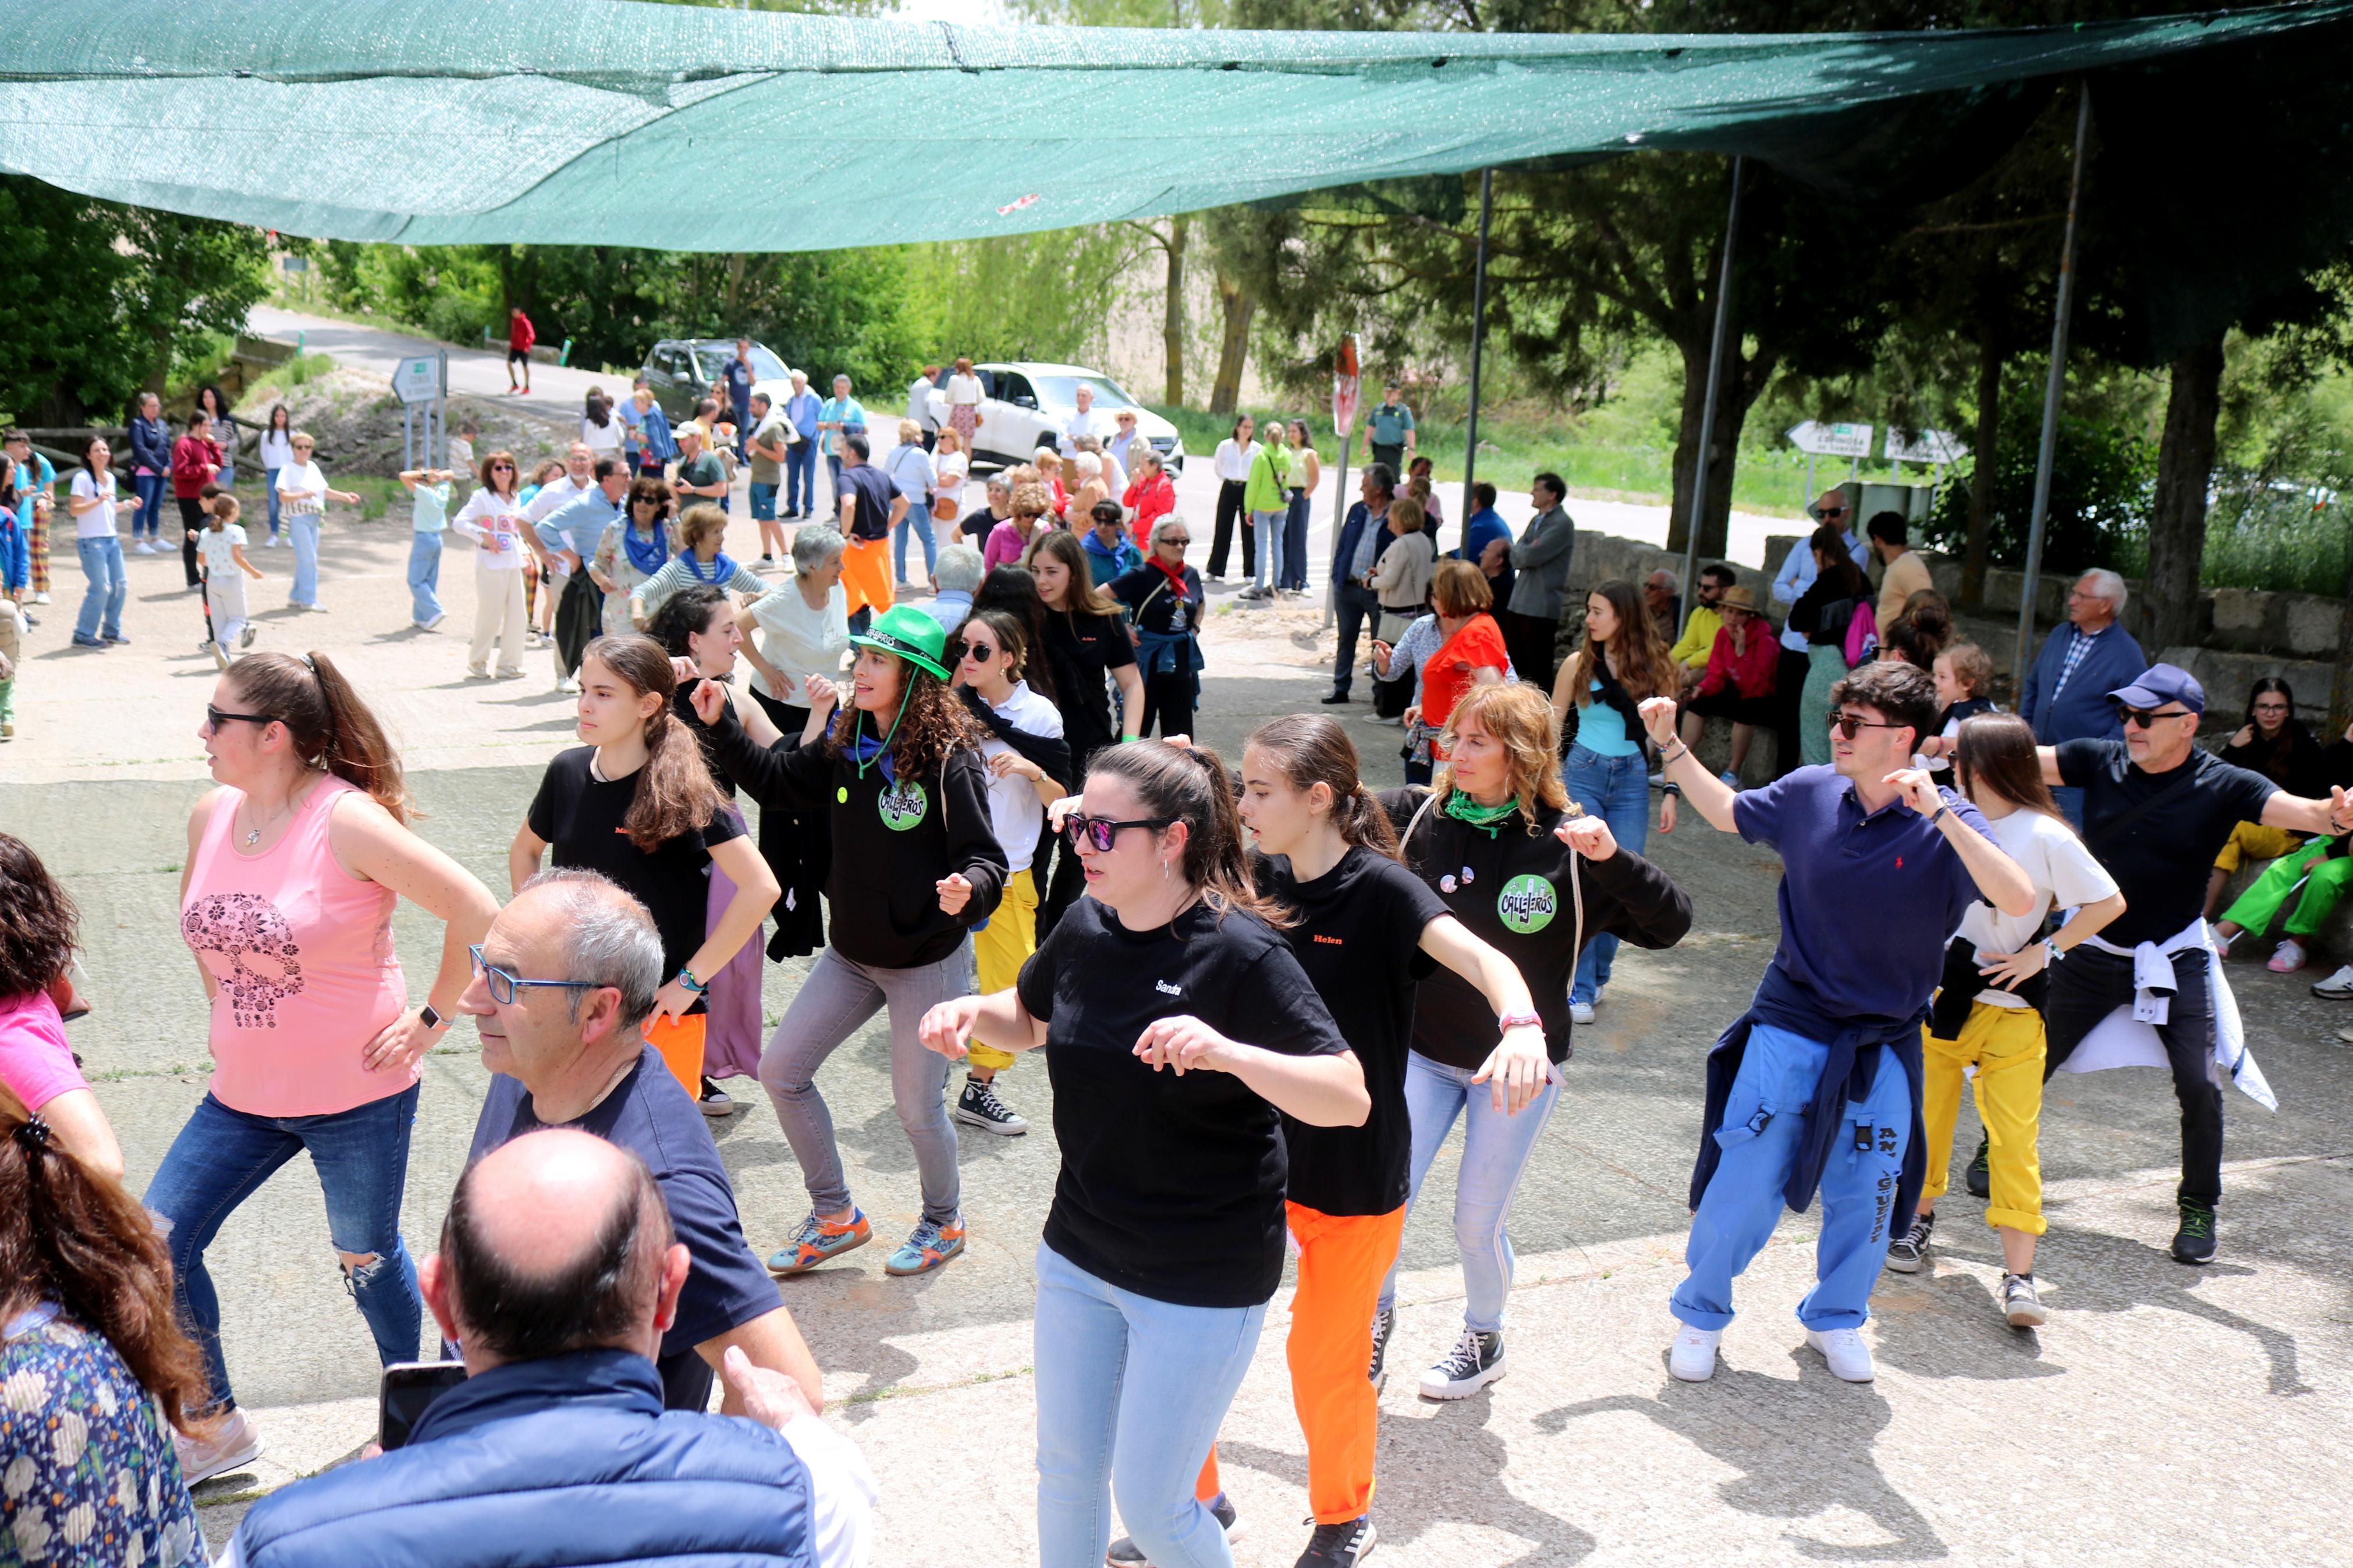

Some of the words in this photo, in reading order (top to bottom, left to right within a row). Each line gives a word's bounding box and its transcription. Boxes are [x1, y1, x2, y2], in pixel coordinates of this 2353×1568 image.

[1502, 893, 1552, 924] CALLEJEROS
[1314, 934, 1342, 945] Helen
[1155, 979, 1181, 996] Sandra
